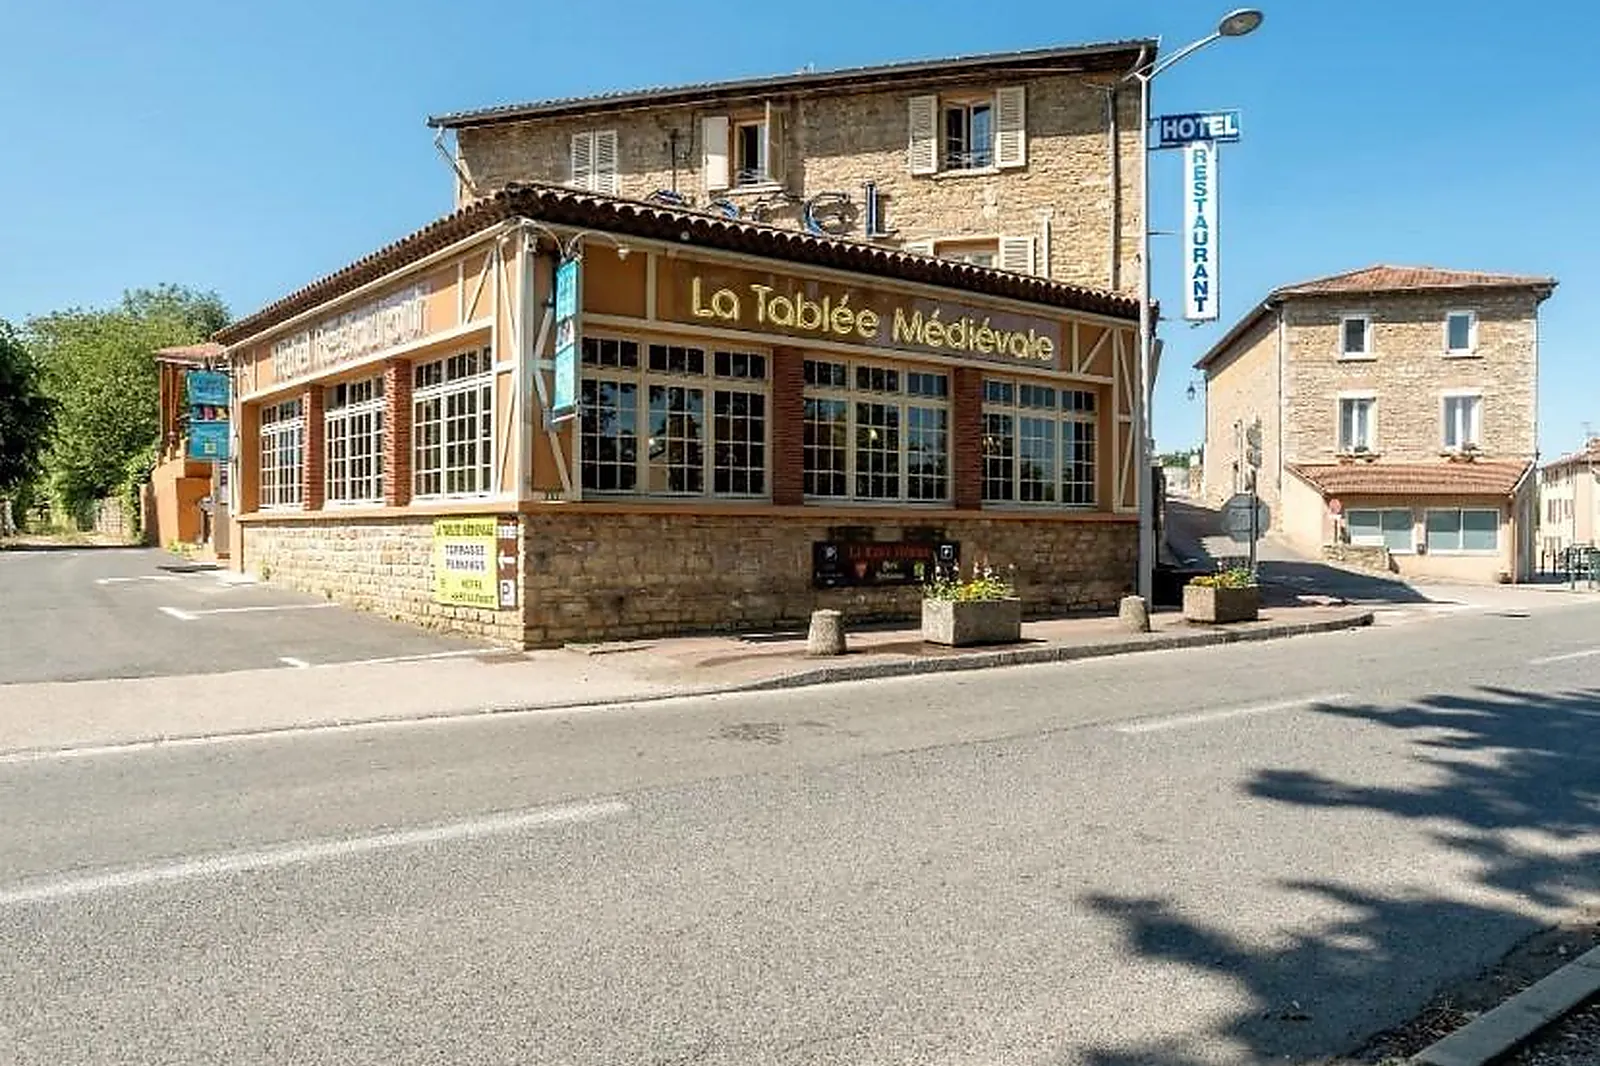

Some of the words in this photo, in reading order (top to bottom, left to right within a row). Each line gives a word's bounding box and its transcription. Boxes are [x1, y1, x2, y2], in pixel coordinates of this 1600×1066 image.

[1163, 113, 1238, 140] HOTEL
[1192, 148, 1209, 312] RESTAURANT
[692, 276, 740, 321] La
[749, 283, 880, 339] Tablée
[891, 307, 1054, 362] Médiévale
